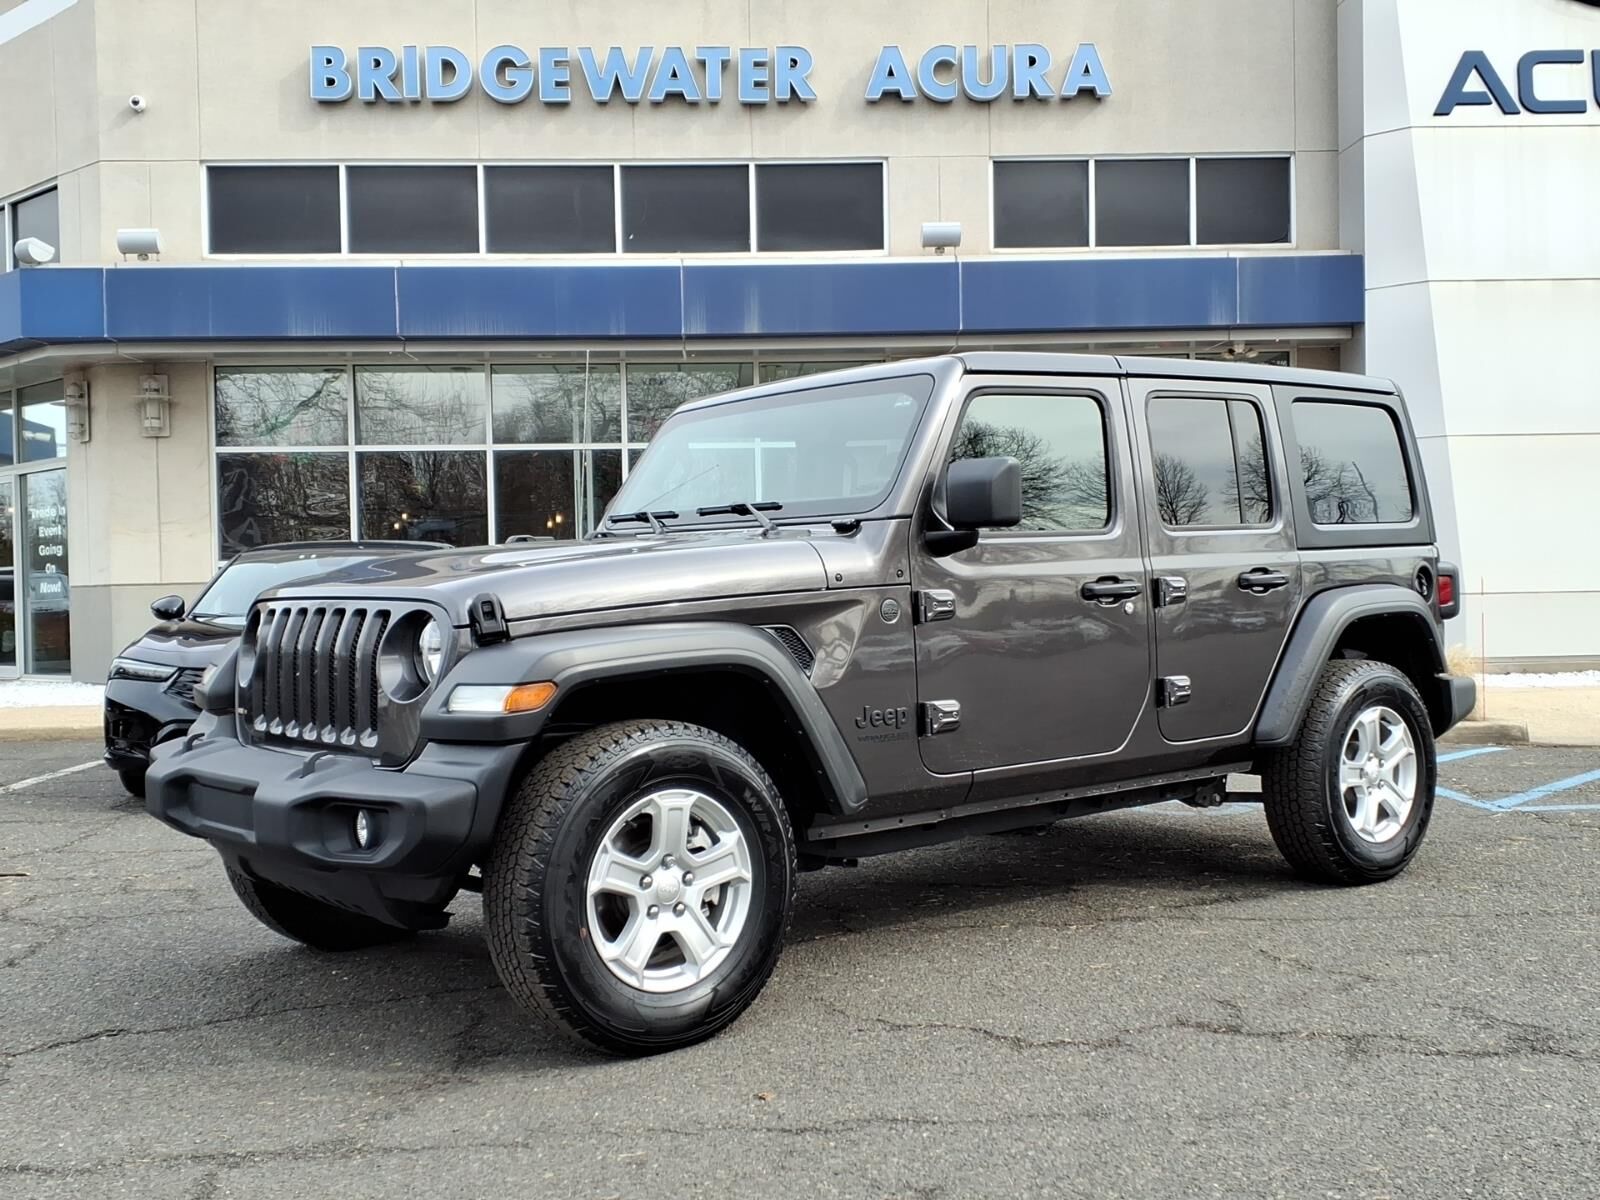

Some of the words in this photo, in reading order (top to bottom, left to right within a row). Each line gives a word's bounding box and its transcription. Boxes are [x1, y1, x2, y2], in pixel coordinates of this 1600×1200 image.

[309, 43, 818, 105] BRIDGEWATER
[864, 42, 1113, 102] ACURA
[1433, 49, 1600, 116] AC
[30, 505, 57, 519] Trade
[38, 524, 62, 537] Event
[38, 543, 63, 557] Going
[45, 563, 56, 574] On
[39, 581, 62, 594] Now!
[855, 705, 908, 729] Jeep
